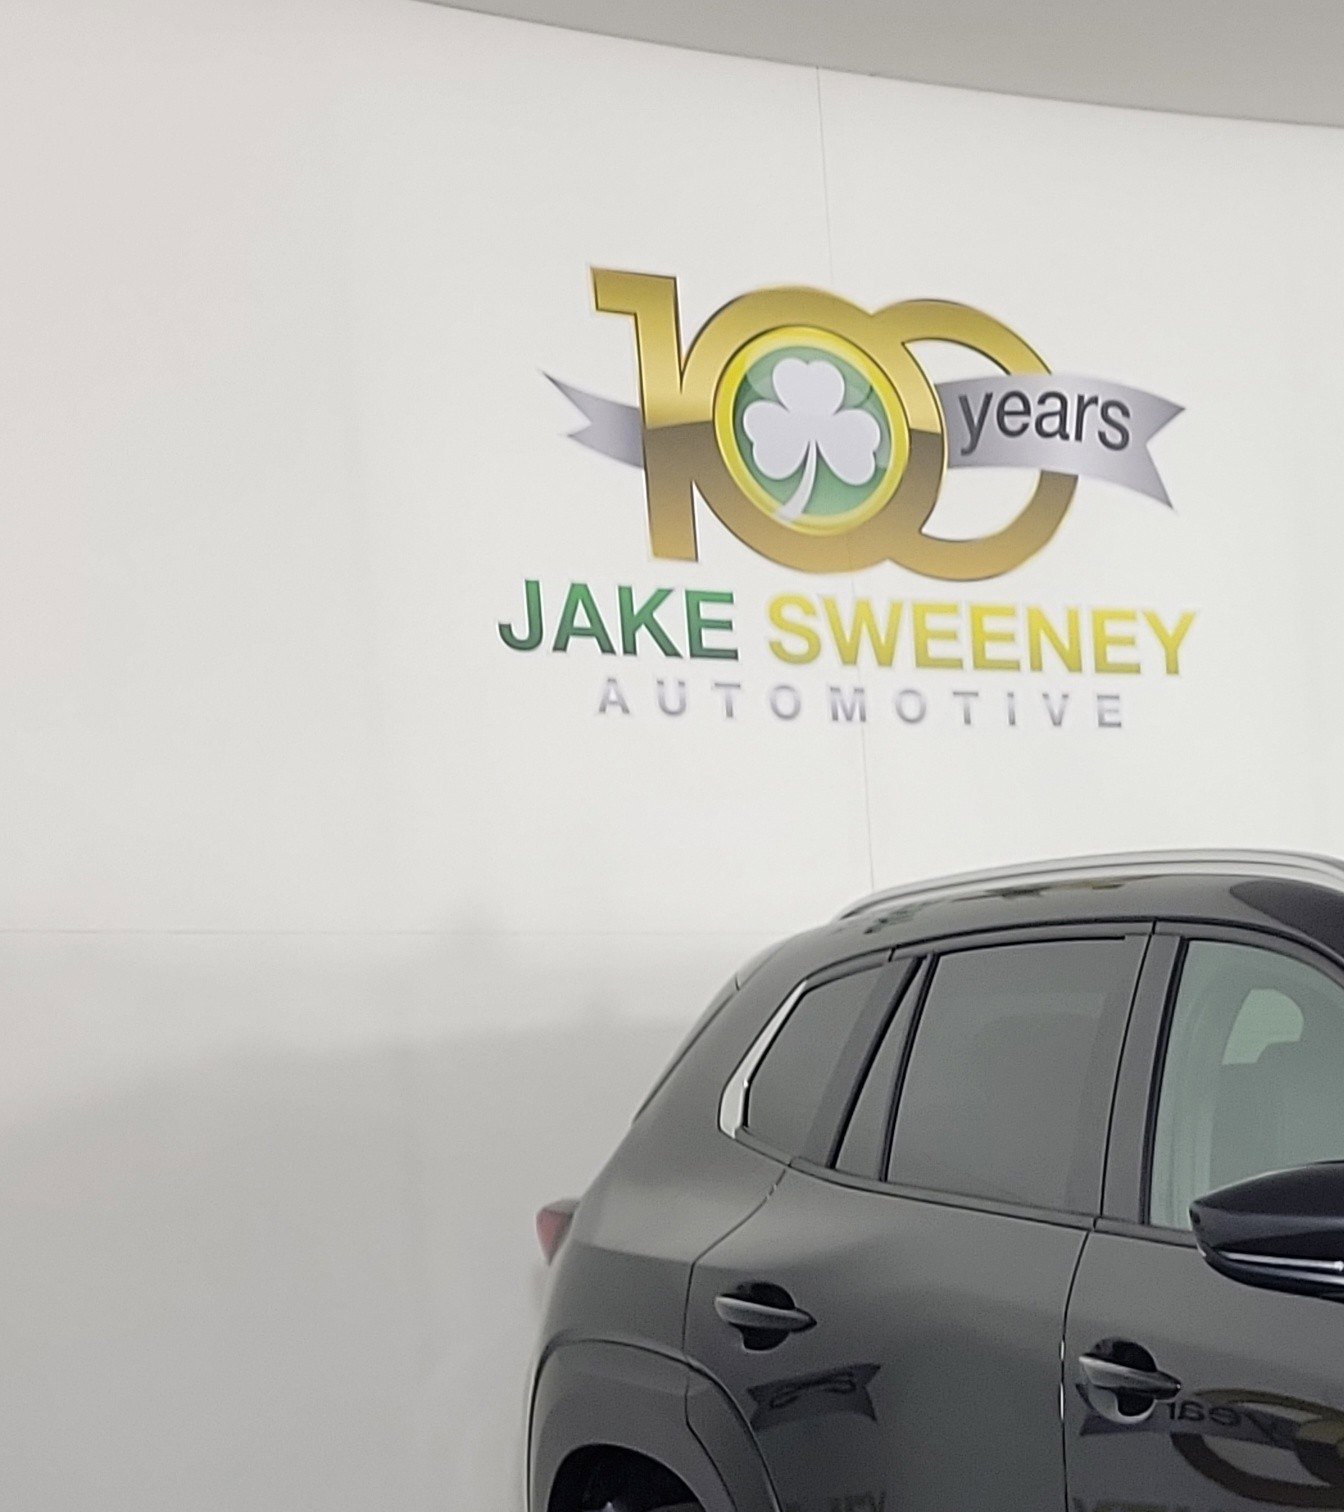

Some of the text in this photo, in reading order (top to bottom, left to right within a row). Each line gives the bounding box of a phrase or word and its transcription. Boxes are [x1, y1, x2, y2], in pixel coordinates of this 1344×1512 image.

[589, 265, 1132, 583] 100 years
[498, 579, 1197, 677] JAKE SWEENEY
[597, 678, 1124, 730] AUTOMOTIVE
